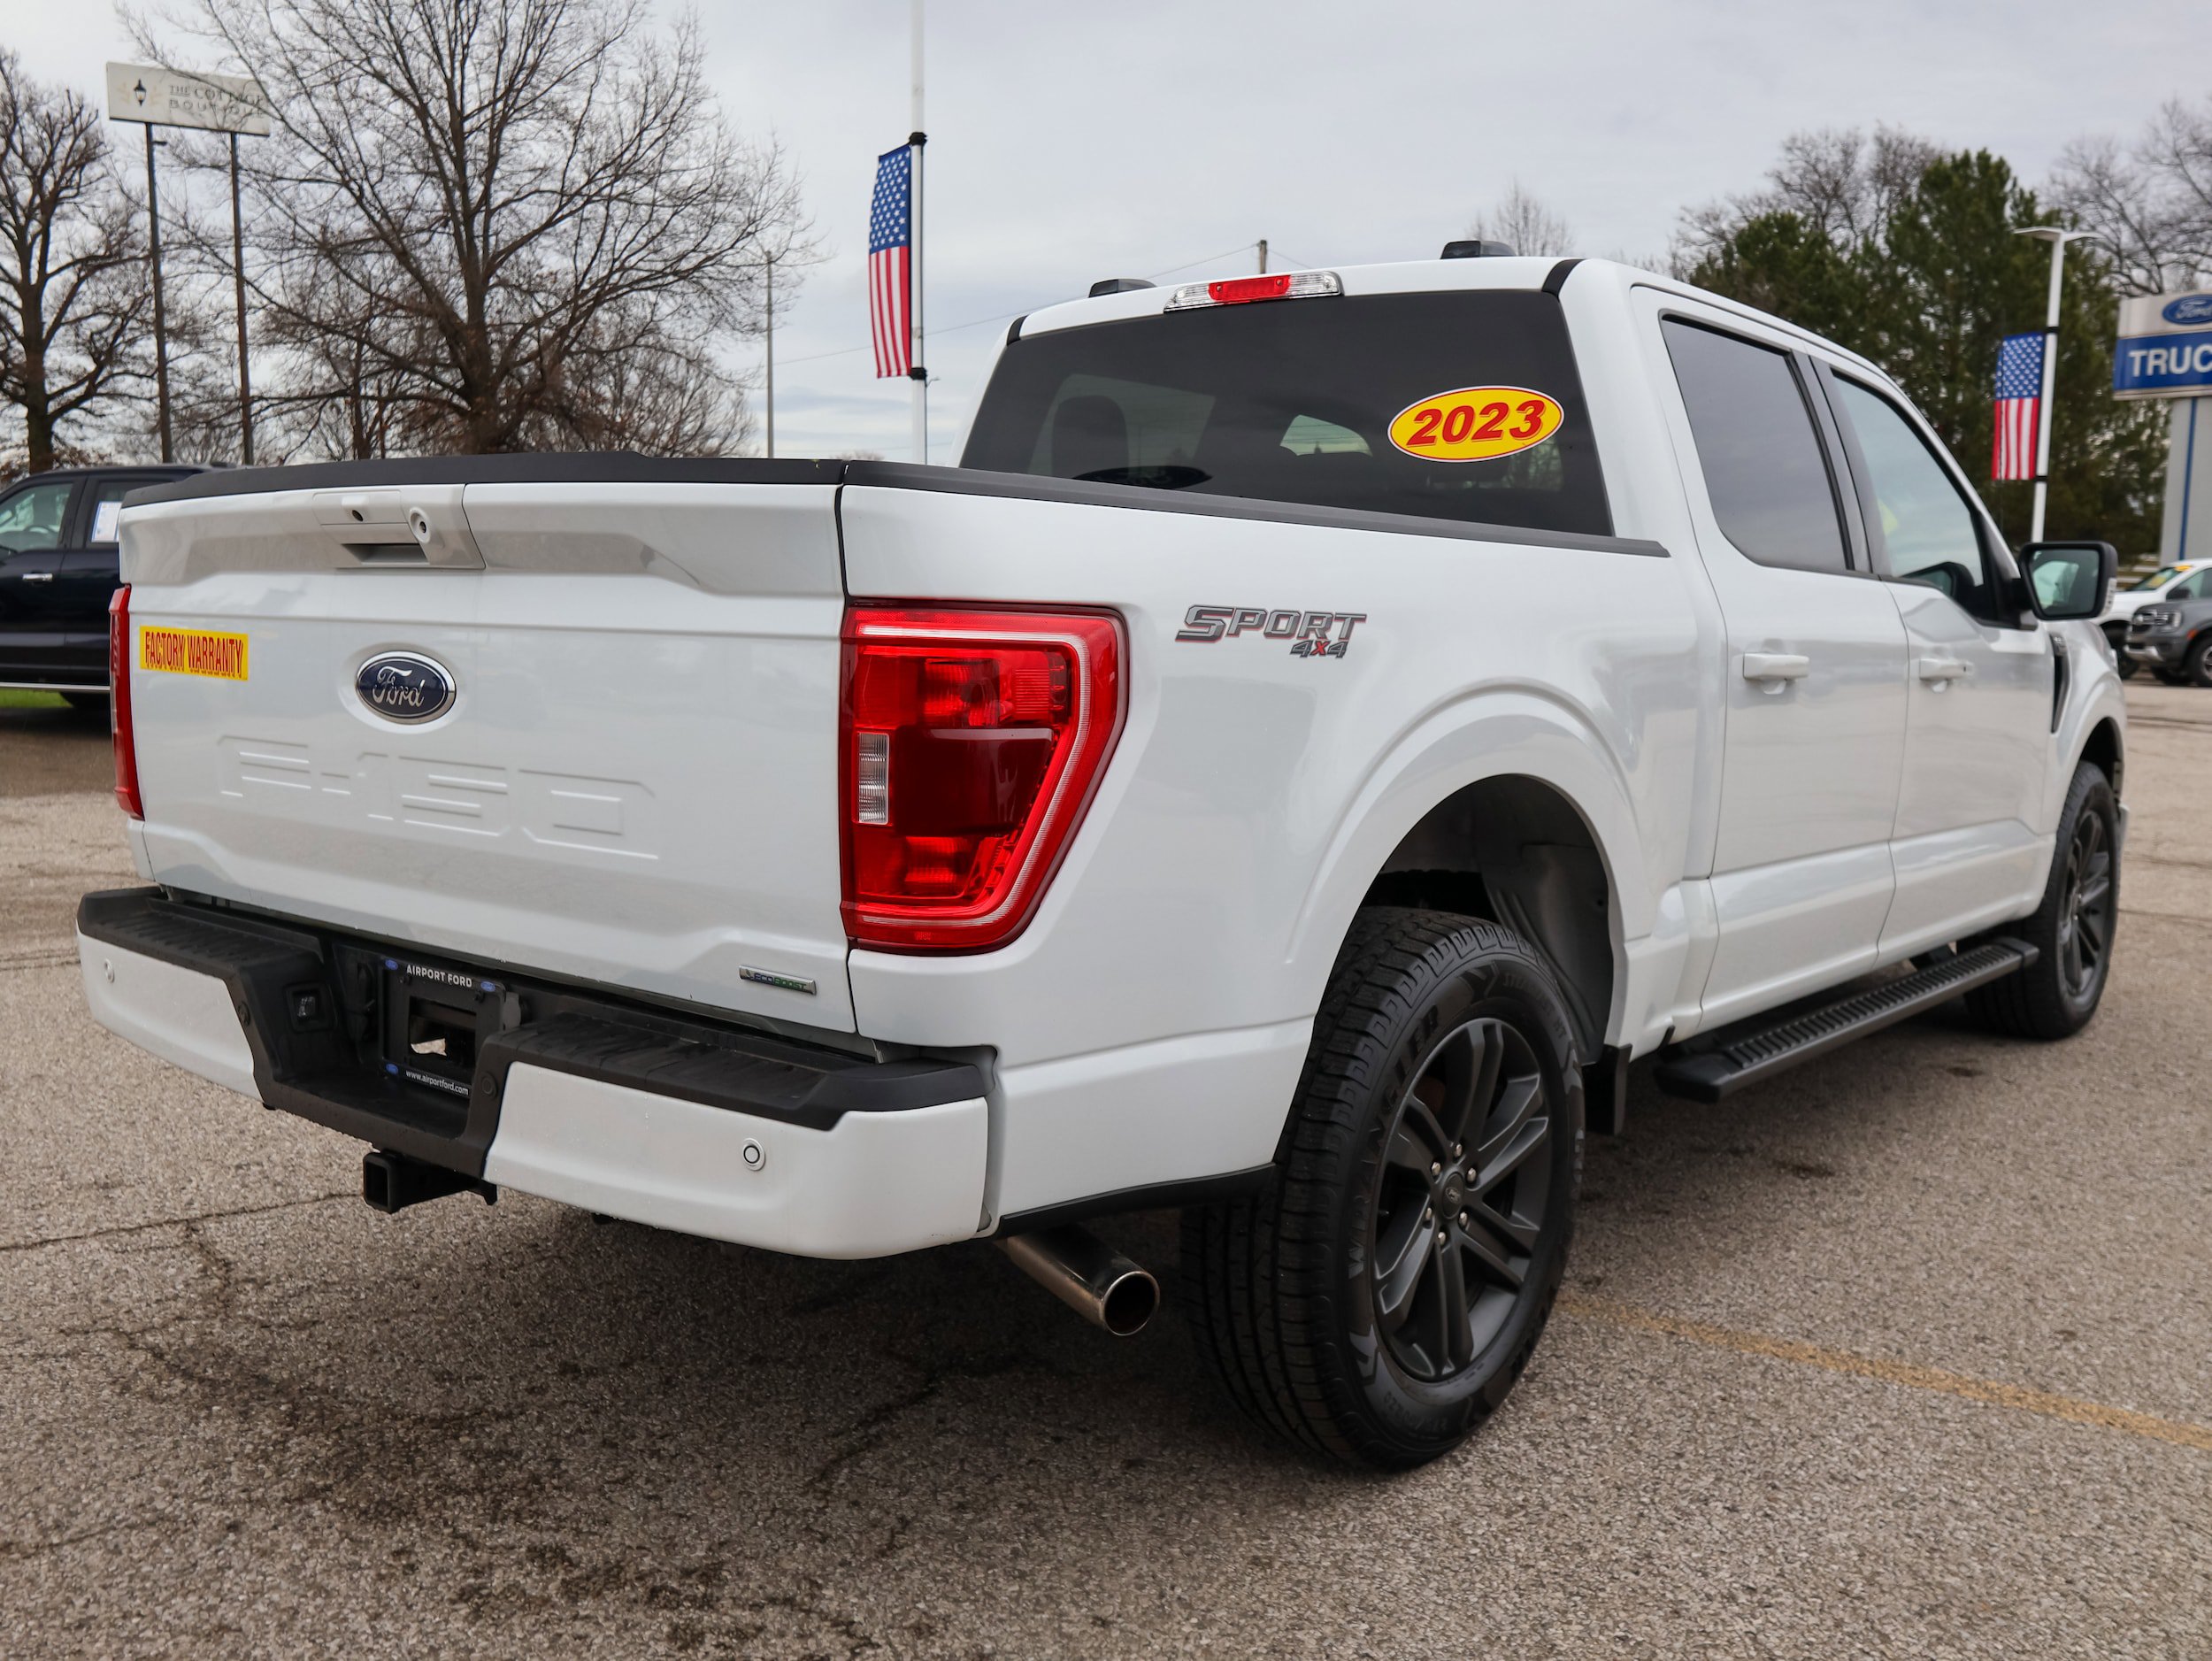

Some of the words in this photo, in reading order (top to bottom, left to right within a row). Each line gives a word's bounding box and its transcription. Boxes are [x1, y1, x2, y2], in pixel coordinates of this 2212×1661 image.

[170, 99, 263, 118] BOUQUE
[195, 88, 263, 106] COTGE
[1406, 399, 1546, 447] 2023
[1174, 604, 1367, 643] SPORT
[145, 631, 185, 671] FACTORY
[187, 634, 243, 677] WARRANTY
[372, 665, 426, 707] Ford
[217, 734, 659, 859] F-150
[406, 964, 445, 981] AIRPORT
[448, 973, 472, 988] FORD
[405, 1069, 469, 1096] www.airportford.com
